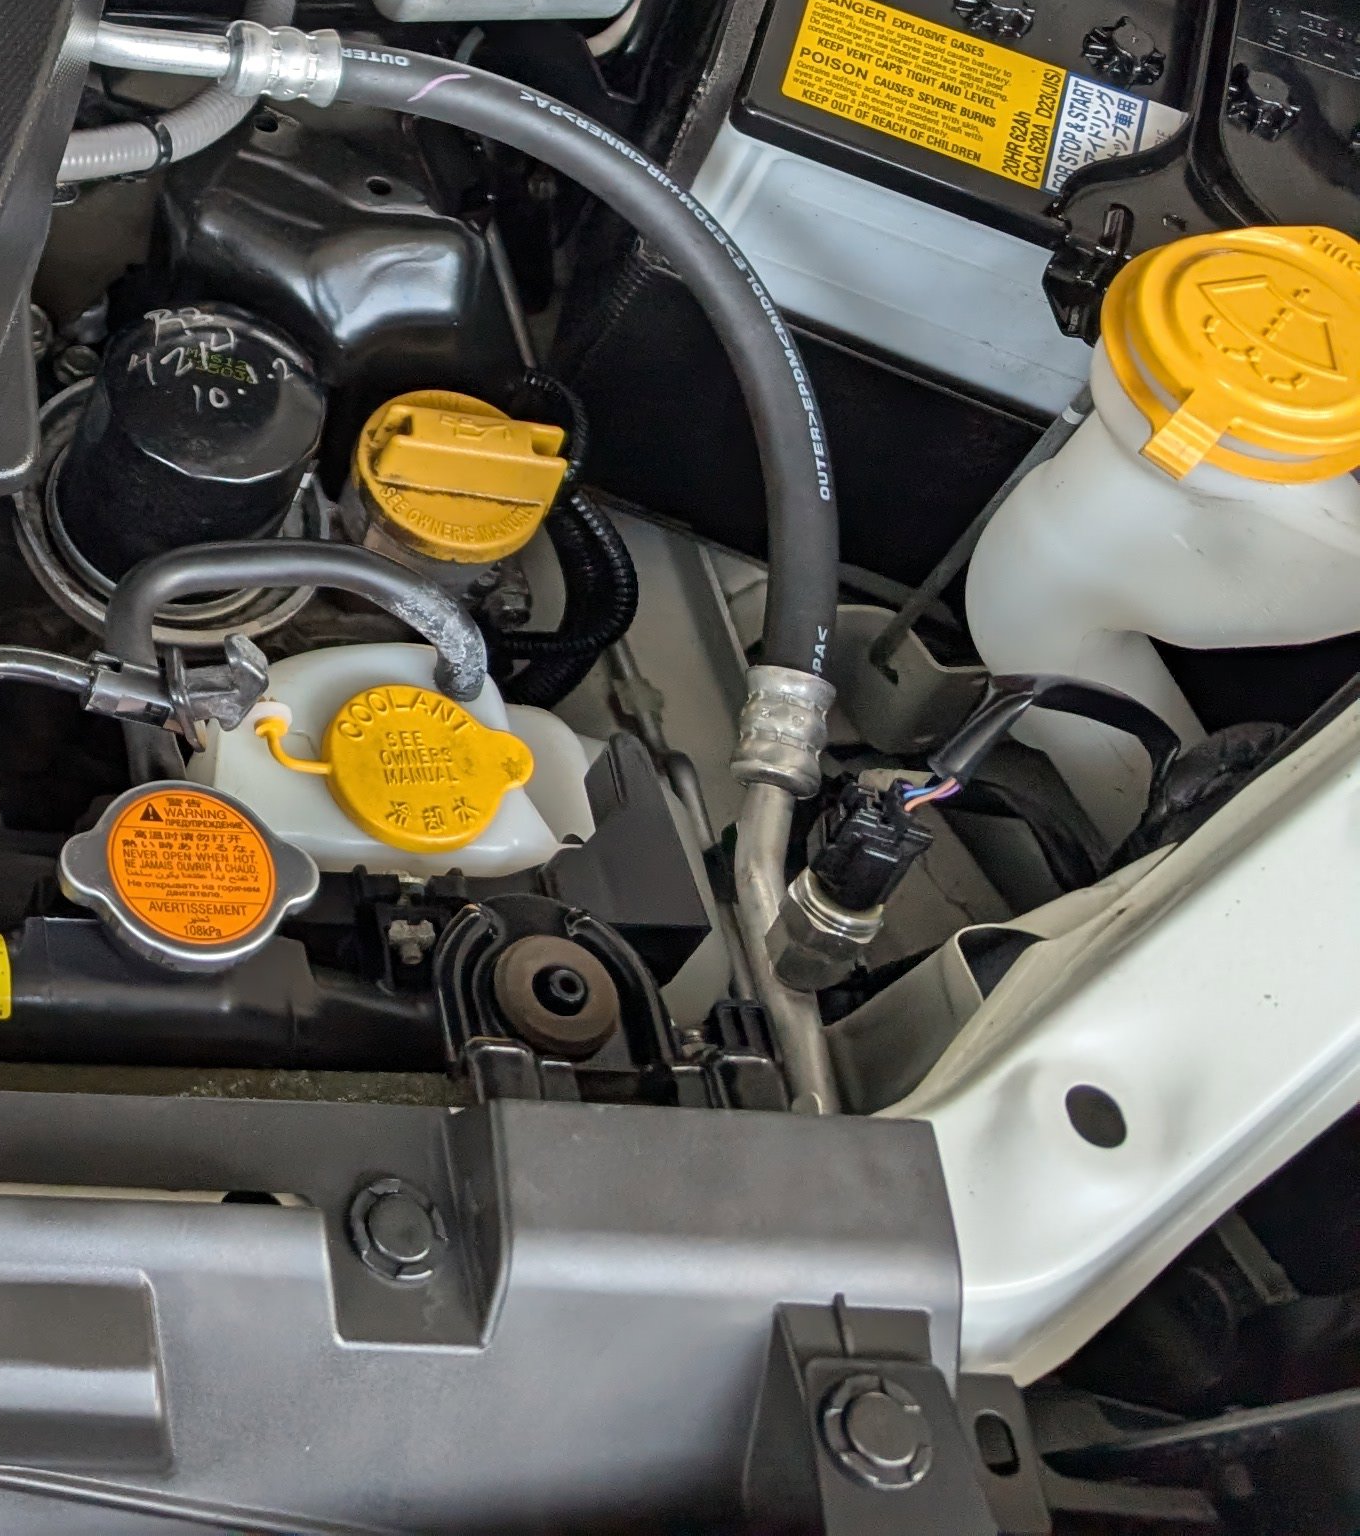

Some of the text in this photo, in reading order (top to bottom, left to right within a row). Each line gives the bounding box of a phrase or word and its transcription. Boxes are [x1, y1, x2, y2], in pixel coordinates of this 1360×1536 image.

[807, 23, 853, 45] connections
[854, 40, 885, 56] without
[885, 53, 911, 68] proper
[913, 62, 957, 83] instruction
[958, 78, 974, 88] and
[809, 16, 821, 25] Do
[821, 21, 835, 30] not
[835, 26, 863, 42] charge
[874, 41, 888, 50] use
[889, 45, 920, 61] booster
[921, 56, 948, 71] cables
[948, 67, 958, 75] or
[958, 70, 984, 85] adjust
[985, 80, 1003, 92] post
[846, 21, 876, 38] Always
[877, 32, 901, 46] shield
[902, 42, 921, 54] eyes
[923, 49, 938, 59] and
[939, 55, 957, 66] face
[958, 62, 978, 74] from
[891, 17, 947, 44] EXPLOSIVE
[950, 38, 985, 57] GASES
[896, 31, 923, 47] sparks
[923, 41, 946, 54] could
[946, 50, 970, 63] cause
[971, 58, 1001, 75] battery
[1003, 70, 1012, 78] to
[791, 76, 815, 89] water
[817, 84, 833, 95] and
[833, 90, 848, 100] call
[856, 98, 896, 119] physician
[796, 60, 831, 78] Contains
[884, 92, 907, 106] Avoid
[908, 101, 939, 117] contact
[940, 113, 960, 125] with
[798, 46, 997, 128] POISON CAUSES SEVERE BURNS
[816, 36, 997, 109] KEEP VENT CAPS TIGHT AND LEVEL
[793, 68, 813, 80] eyes
[860, 92, 869, 100] In
[870, 96, 890, 108] event
[891, 103, 904, 113] of
[905, 108, 940, 126] accident
[941, 121, 962, 134] flush
[963, 129, 984, 142] with
[800, 89, 982, 162] KEEP OUT OF REACH OF CHILDREN
[1020, 66, 1062, 183] CCA 620A D23(JIS)
[1057, 80, 1094, 166] STOP & START
[1001, 109, 1032, 175] 20HR 62Ah
[381, 486, 533, 542] SEE OWNER'S MANUAL
[338, 689, 478, 741] COOLANT
[386, 731, 424, 749] SEE
[384, 767, 460, 786] MANUAL
[164, 808, 227, 819] WARNING
[123, 849, 258, 864] NEVER OPEN WHEN HOT.
[124, 859, 258, 874] NE JAMAIS OUVRIR CHAUD.
[149, 902, 246, 915] AVERTISSEMENT
[184, 925, 221, 937] 108kPa
